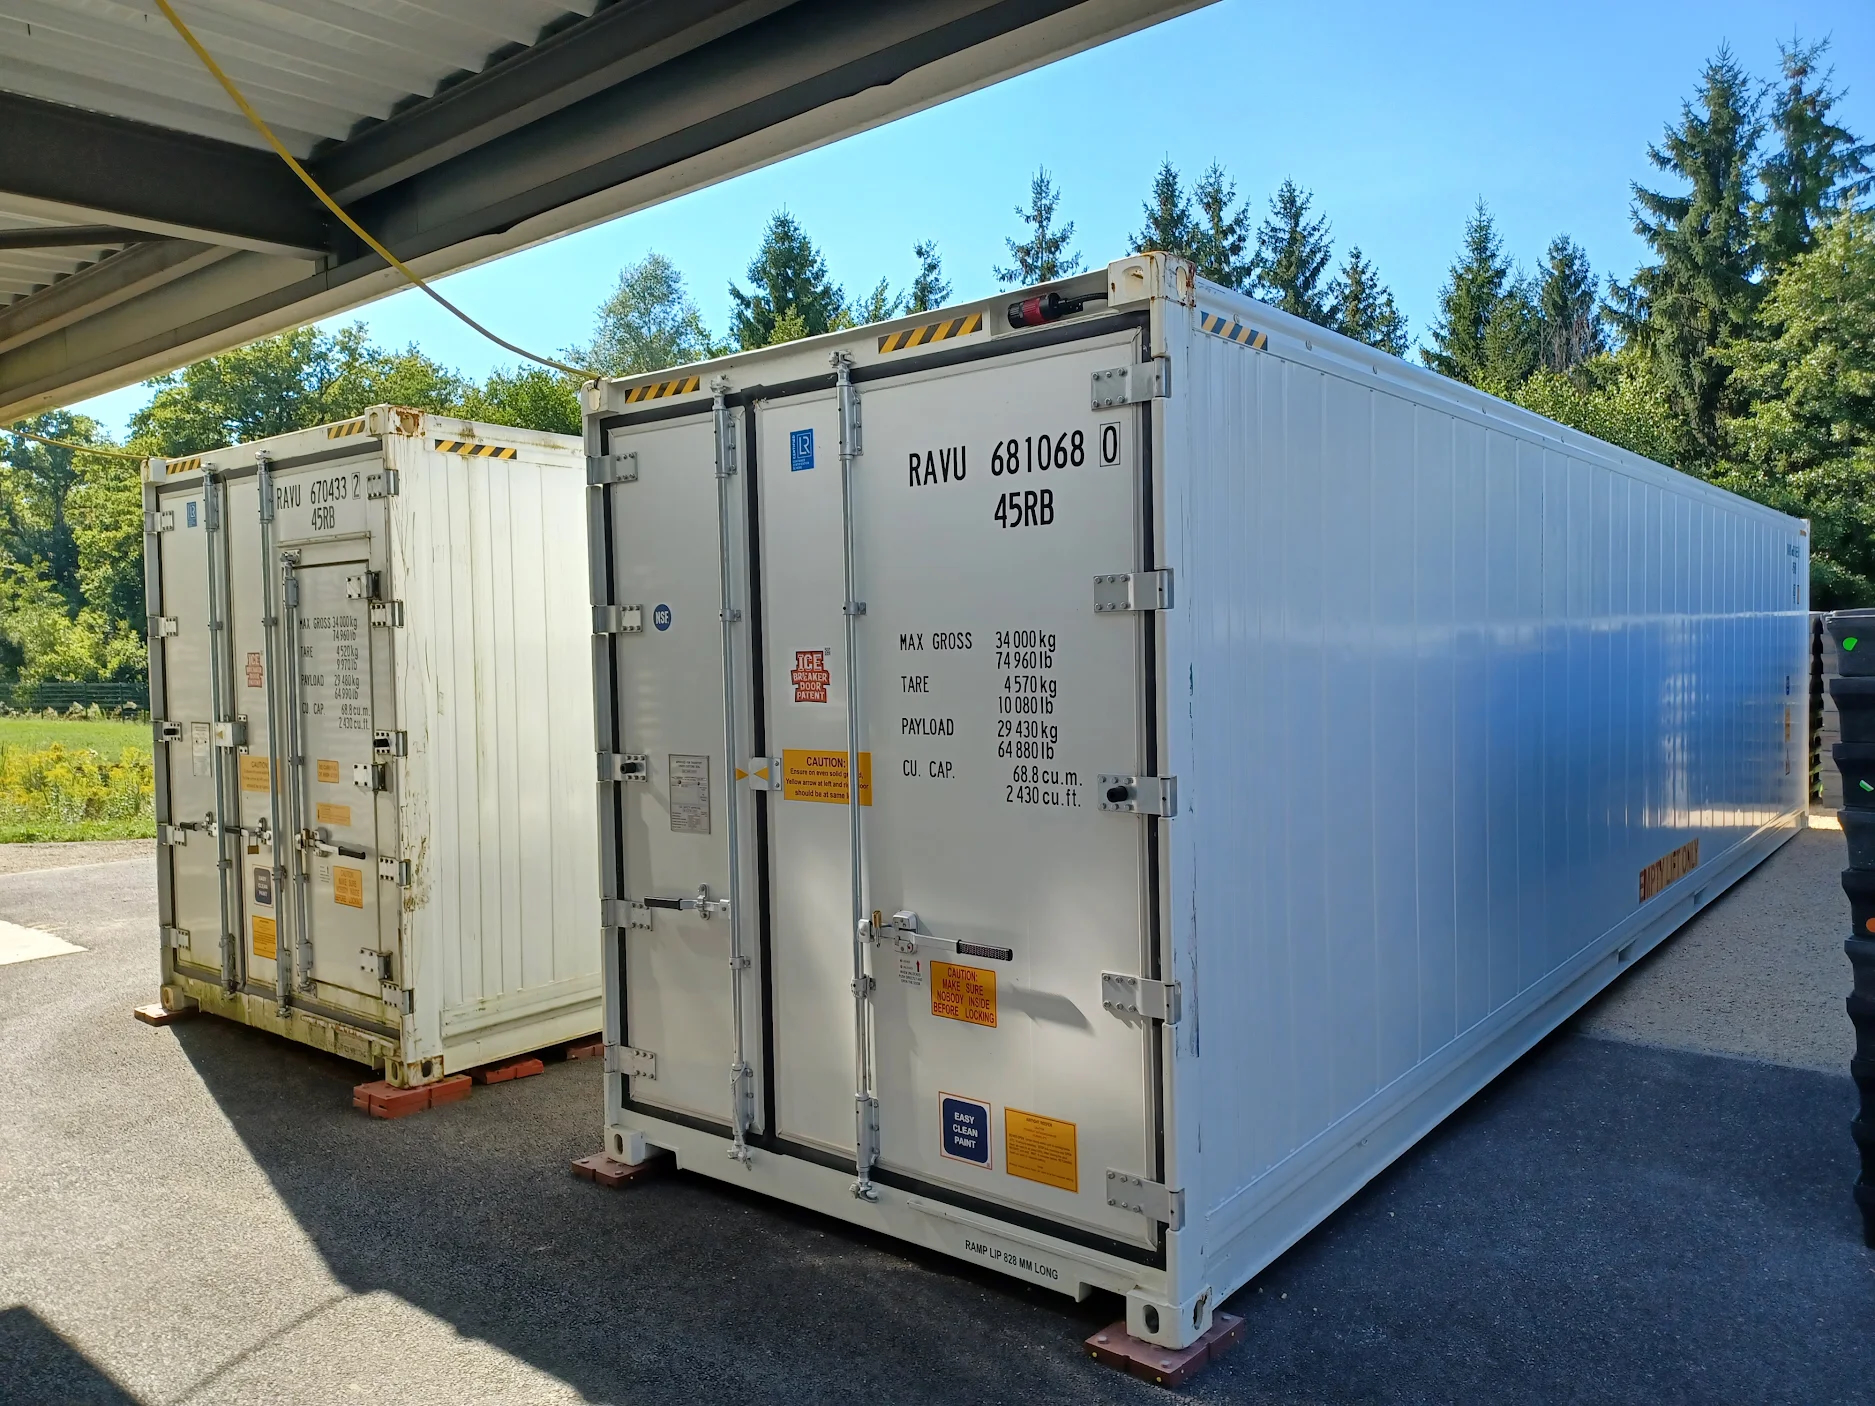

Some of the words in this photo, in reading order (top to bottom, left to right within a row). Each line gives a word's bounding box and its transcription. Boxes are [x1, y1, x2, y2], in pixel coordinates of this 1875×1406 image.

[908, 446, 966, 487] RAVU
[991, 430, 1084, 476] 681068
[1102, 425, 1118, 463] 0
[276, 484, 300, 510] RAVU
[310, 476, 347, 504] 670433
[353, 474, 360, 498] 2
[994, 489, 1054, 528] 45RB
[312, 506, 336, 530] 45RB
[313, 617, 331, 629] GROSS
[900, 634, 924, 650] MAX
[932, 632, 972, 650] GROSS
[300, 646, 313, 658] TARE
[798, 654, 822, 671] ICE
[301, 674, 324, 686] PAYLOAD
[792, 672, 828, 682] BREAKER
[901, 676, 929, 692] TARE
[800, 682, 822, 690] DOOR
[797, 691, 825, 700] PATENT
[902, 718, 954, 736] PAYLOAD
[806, 756, 846, 768] CAUTION:
[902, 760, 921, 777] CU.
[929, 761, 955, 779] CAP.
[948, 967, 978, 982] CAUTION:
[942, 979, 960, 991] MAKE
[966, 983, 984, 996] SURE
[936, 990, 964, 1004] NOBODY
[968, 996, 990, 1010] INSIDE
[934, 1002, 959, 1016] BEFORE
[965, 1008, 994, 1024] LOCKING
[954, 1112, 974, 1124] EASY
[952, 1124, 978, 1138] CLEAN
[954, 1136, 976, 1149] PAINT
[965, 1240, 988, 1255] RAMP
[990, 1248, 1002, 1260] LIP
[1004, 1252, 1017, 1266] 828
[1019, 1258, 1032, 1271] MM
[1034, 1263, 1058, 1280] LONG
